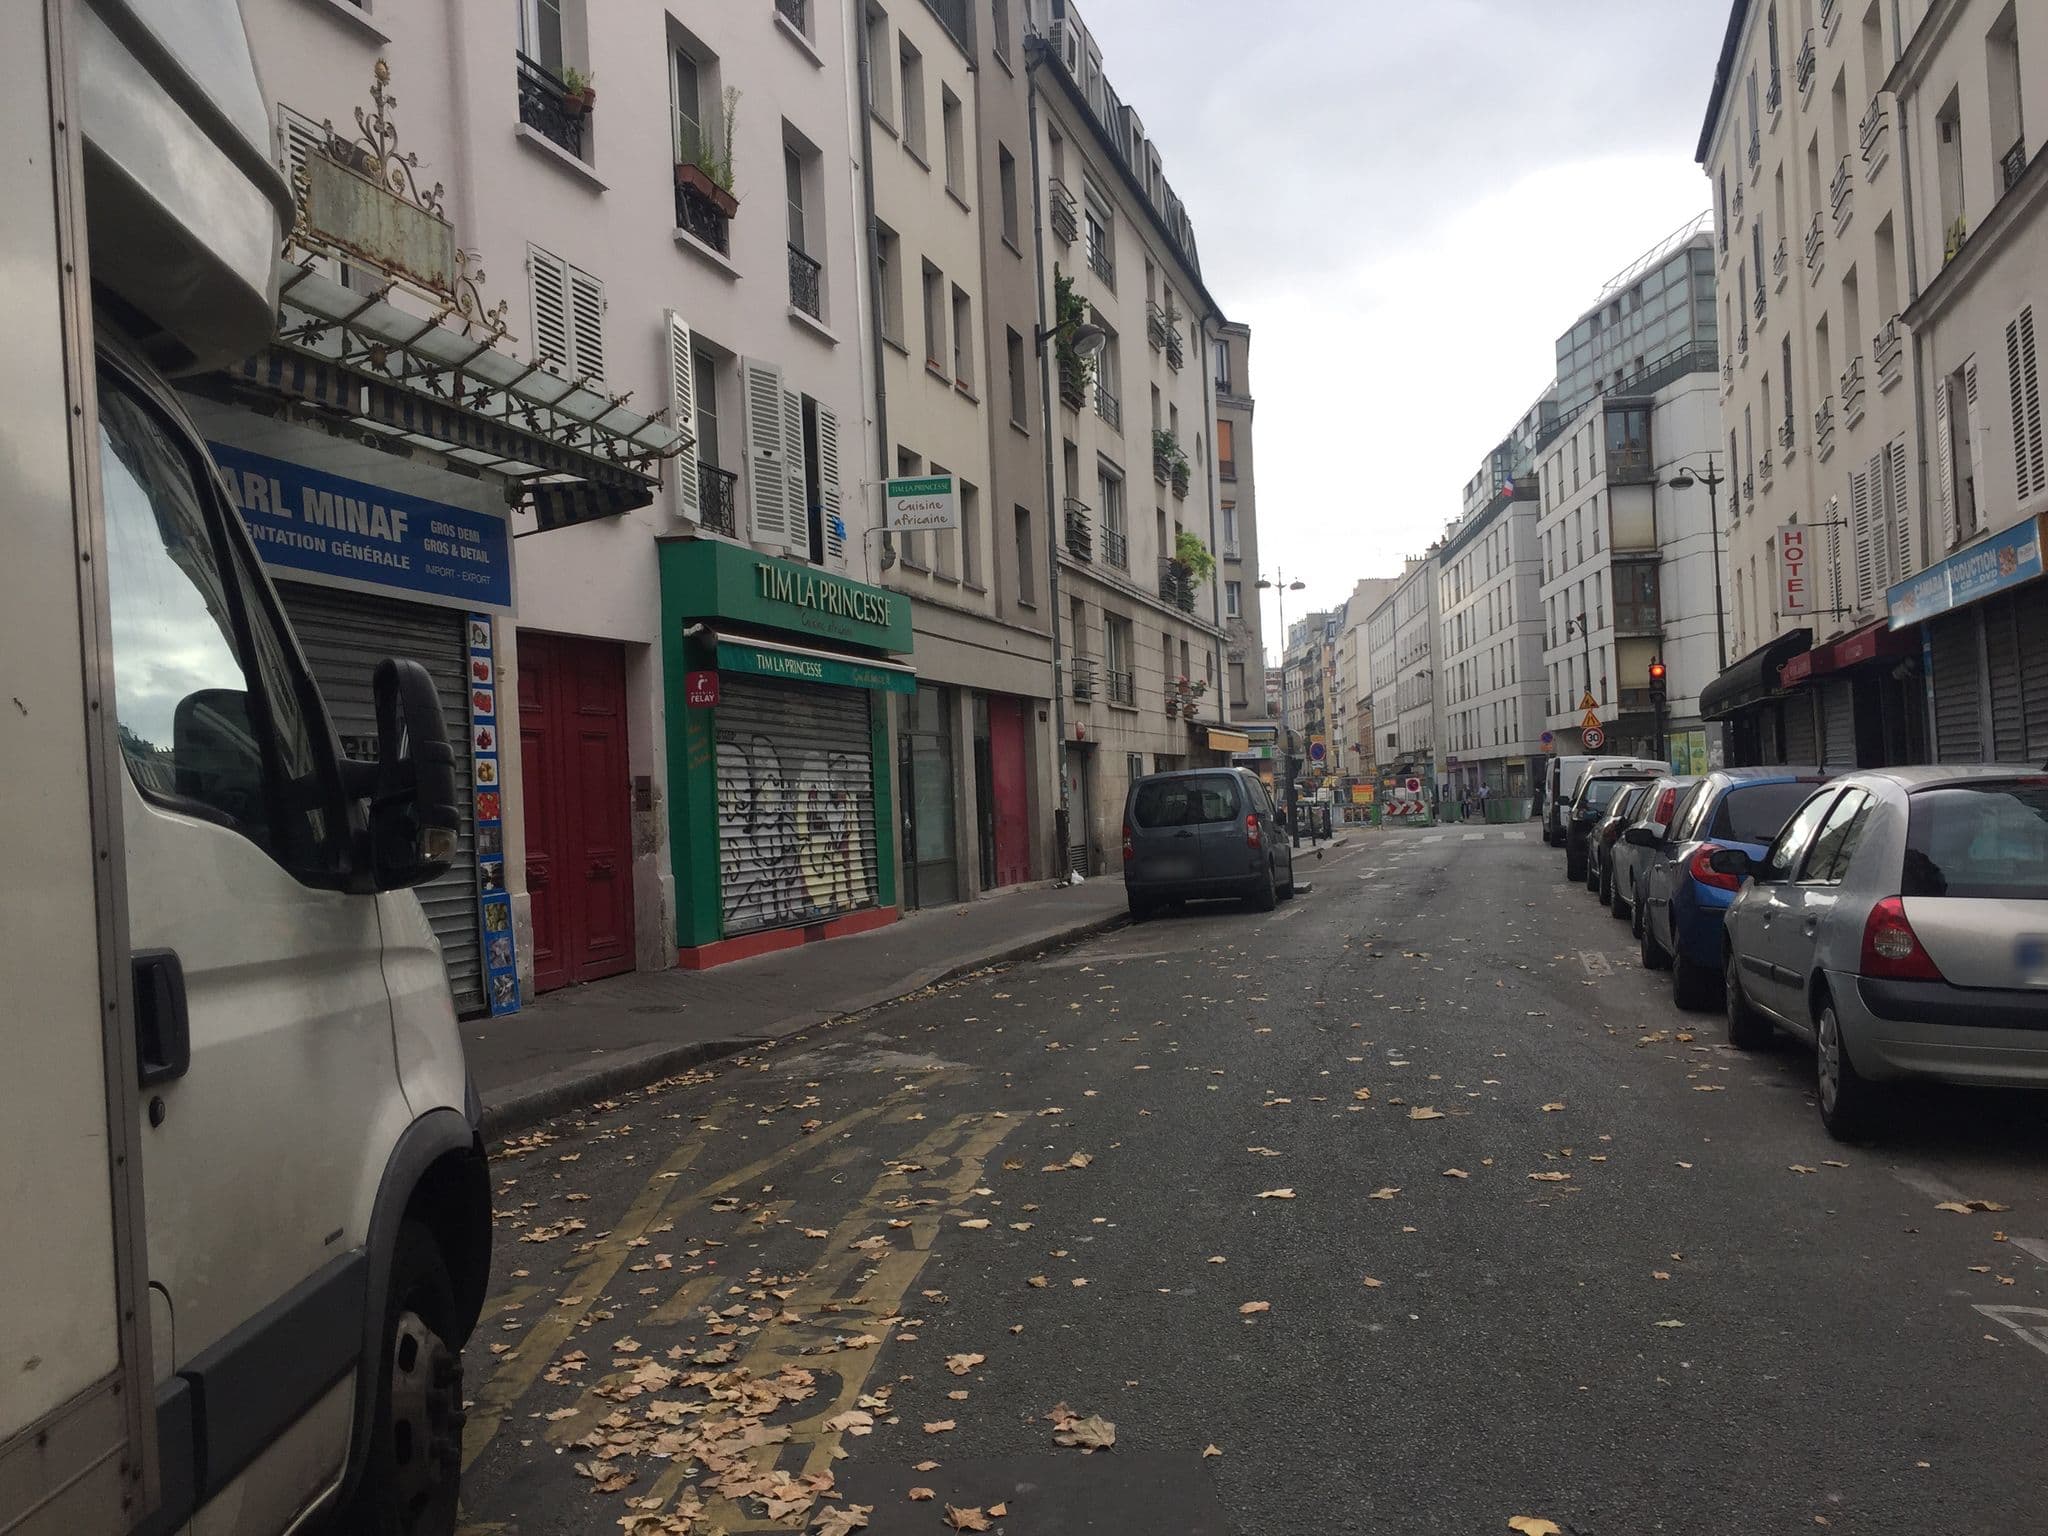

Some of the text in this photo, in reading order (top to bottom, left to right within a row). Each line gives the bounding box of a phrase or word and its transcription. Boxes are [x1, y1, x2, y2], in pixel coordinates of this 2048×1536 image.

[302, 486, 408, 543] MINAF
[897, 499, 943, 511] Cuisine
[895, 513, 948, 526] africaine
[430, 520, 480, 544] GROS DEMI
[331, 540, 410, 570] GÉNÉRALE
[424, 537, 449, 555] GROS
[451, 543, 459, 557] &
[425, 563, 455, 579] IMPORT
[462, 571, 491, 585] EXPORT
[1784, 531, 1804, 608] HOTEL
[758, 562, 793, 603] TIM
[797, 573, 817, 609] LA
[820, 579, 892, 626] PRINCESSE
[756, 654, 823, 678] TIM LA PRINCESSE
[1588, 733, 1599, 742] 30
